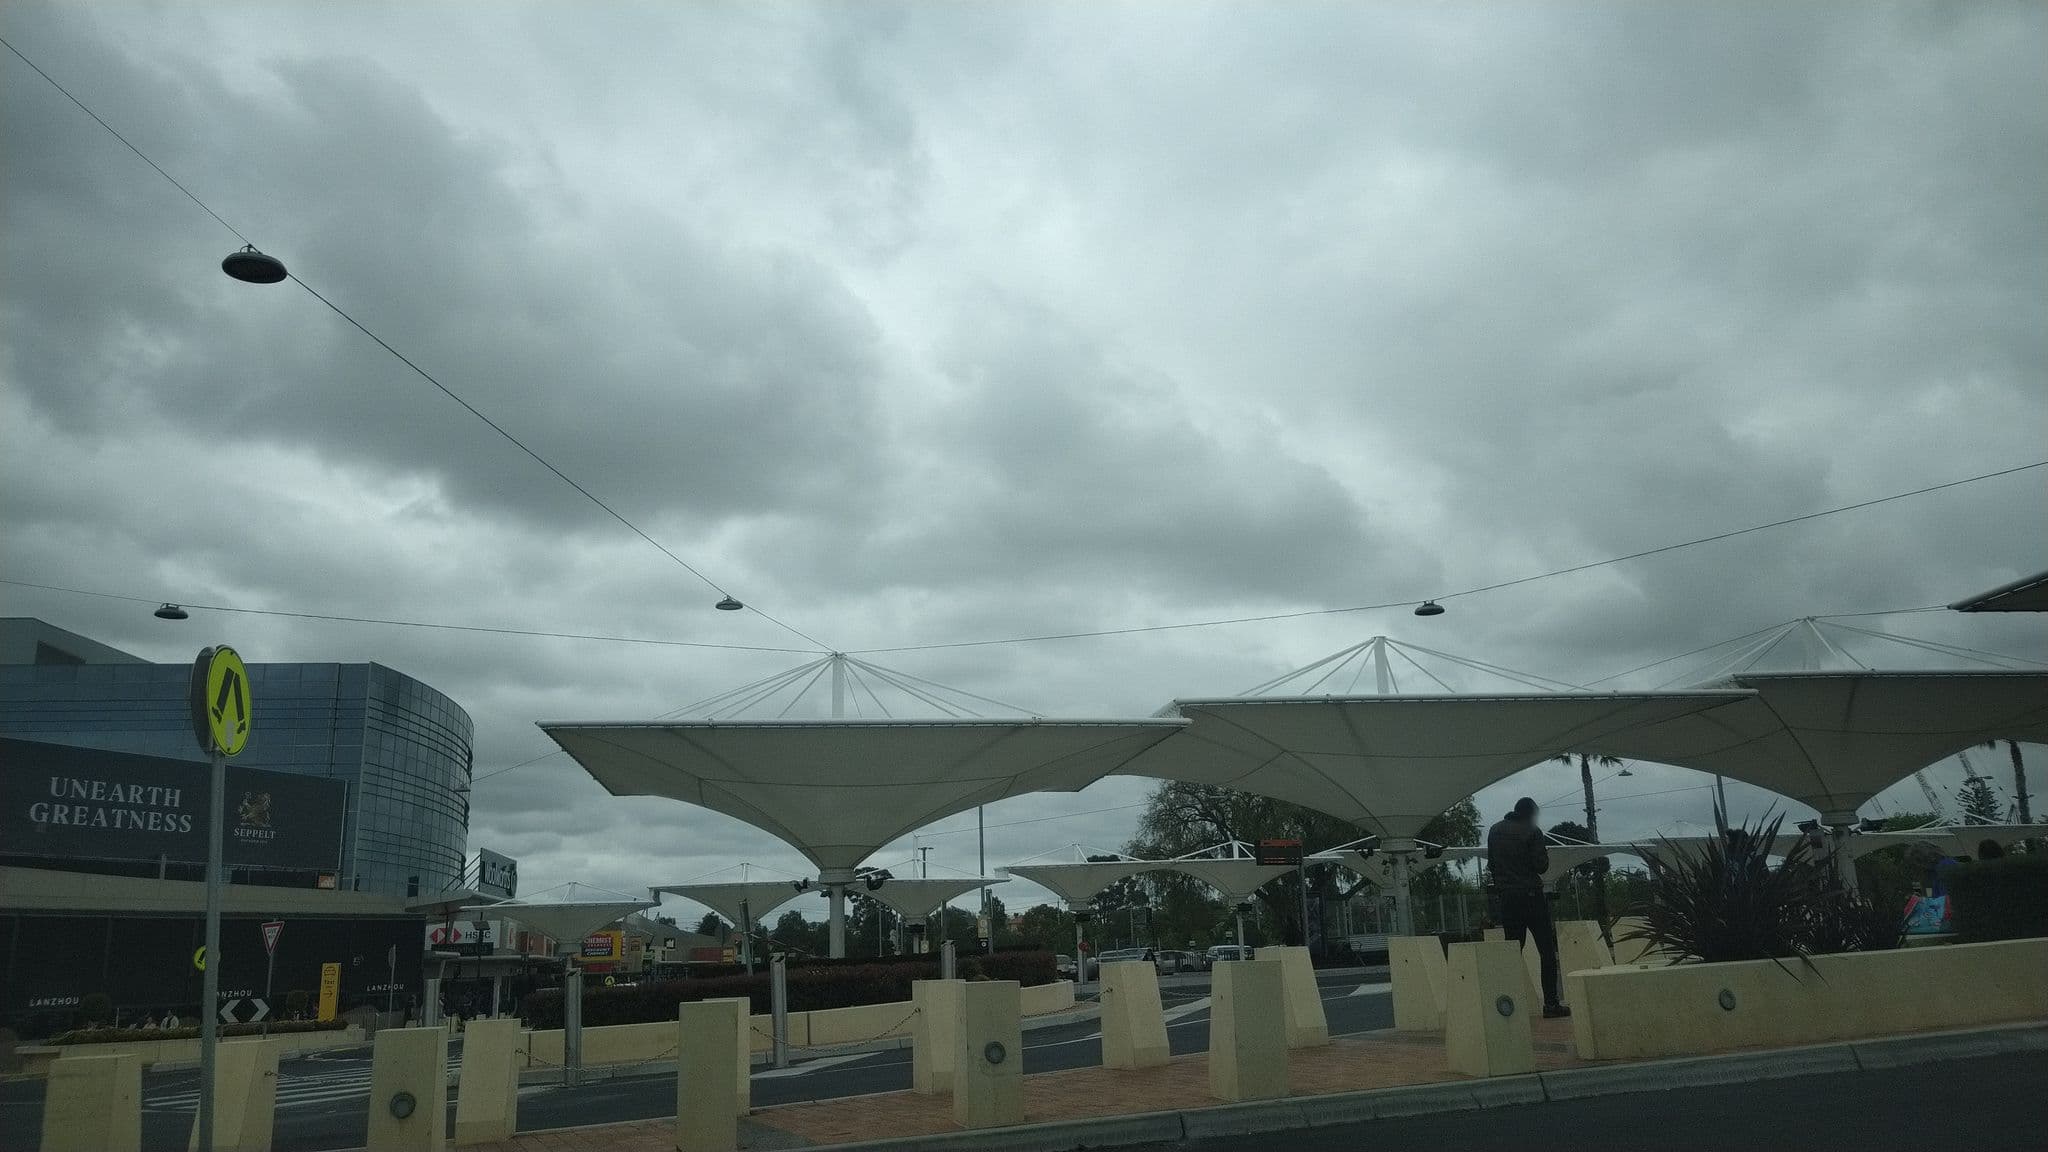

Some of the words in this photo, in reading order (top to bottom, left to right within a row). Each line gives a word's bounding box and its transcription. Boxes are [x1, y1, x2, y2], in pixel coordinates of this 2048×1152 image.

[50, 776, 181, 807] UNEARTH
[29, 802, 193, 832] GREATNESS
[234, 828, 276, 839] SEPPELT
[217, 989, 252, 998] NZHOU
[366, 984, 404, 992] LANZHOU
[29, 996, 80, 1007] LANZHOU
